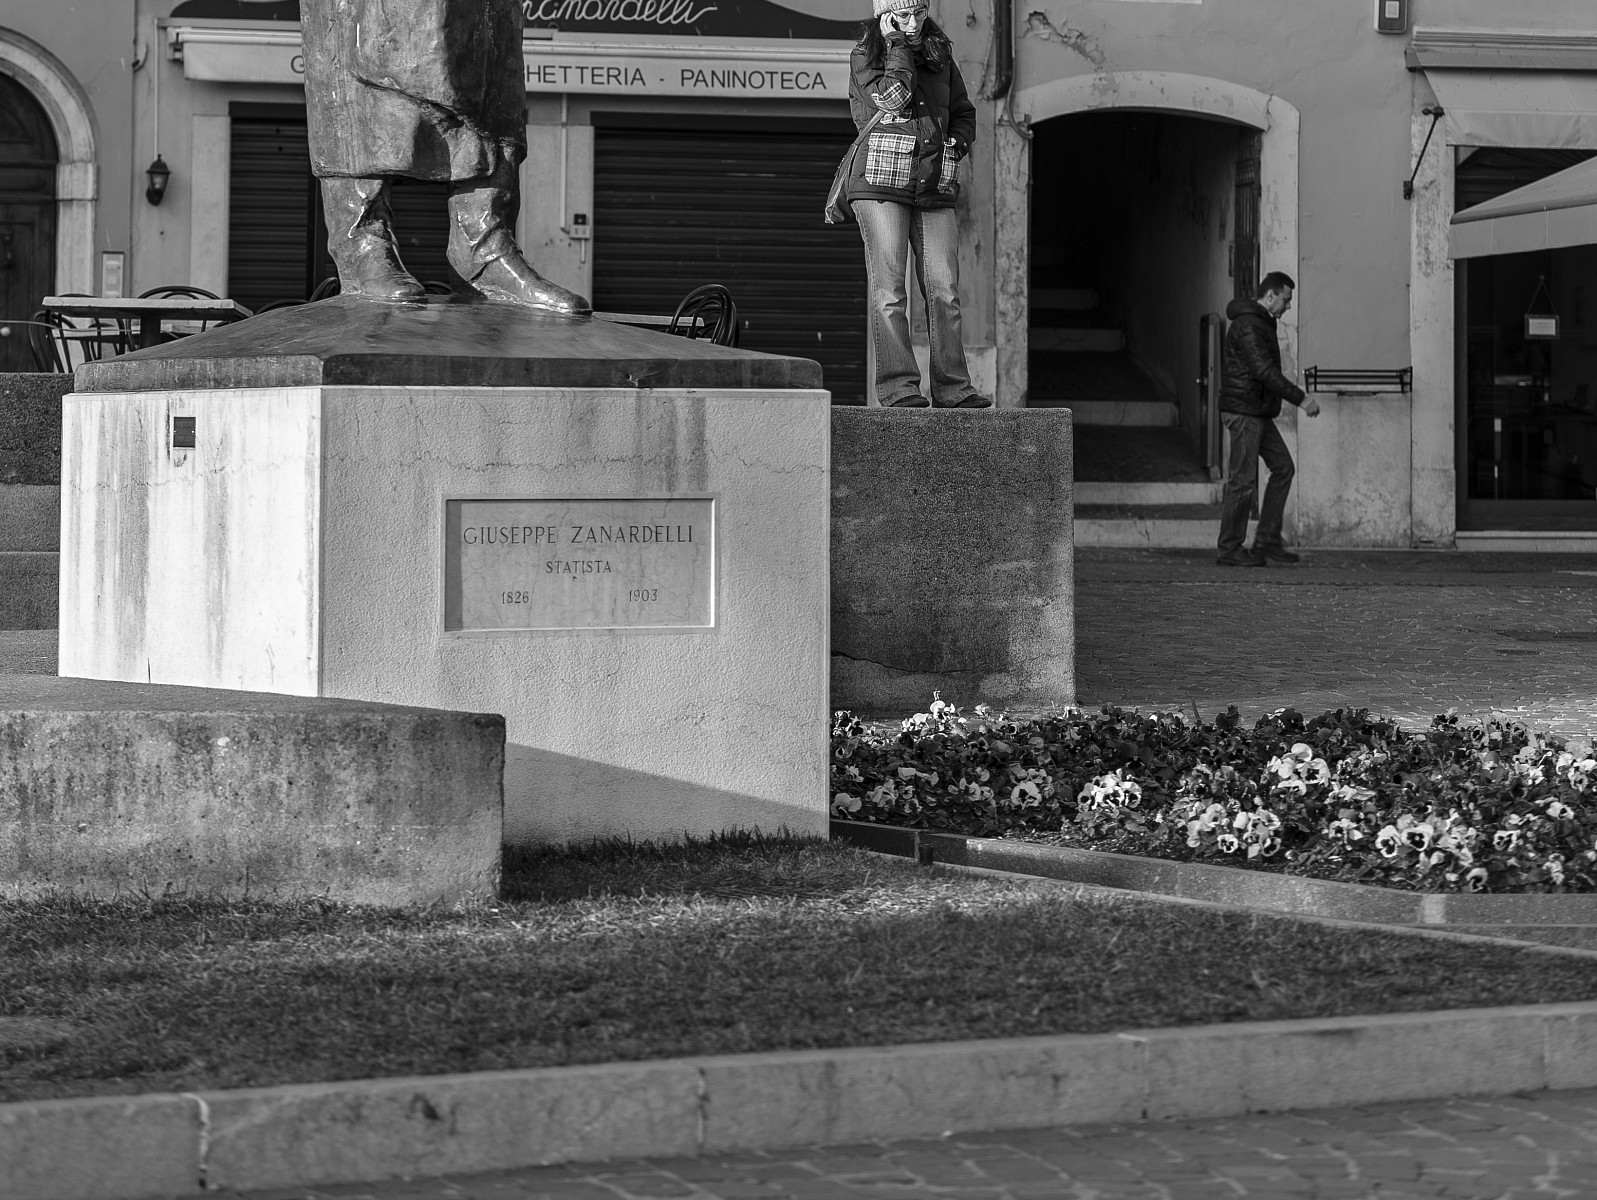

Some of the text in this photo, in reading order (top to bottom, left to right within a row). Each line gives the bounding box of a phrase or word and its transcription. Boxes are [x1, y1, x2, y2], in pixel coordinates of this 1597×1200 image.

[525, 64, 646, 87] HETTERIA
[680, 68, 828, 91] PANINOTECA
[462, 524, 694, 545] GIUSEPPE ZANARDELLI
[545, 560, 613, 575] STATISTA
[501, 588, 659, 605] 1826 1903
